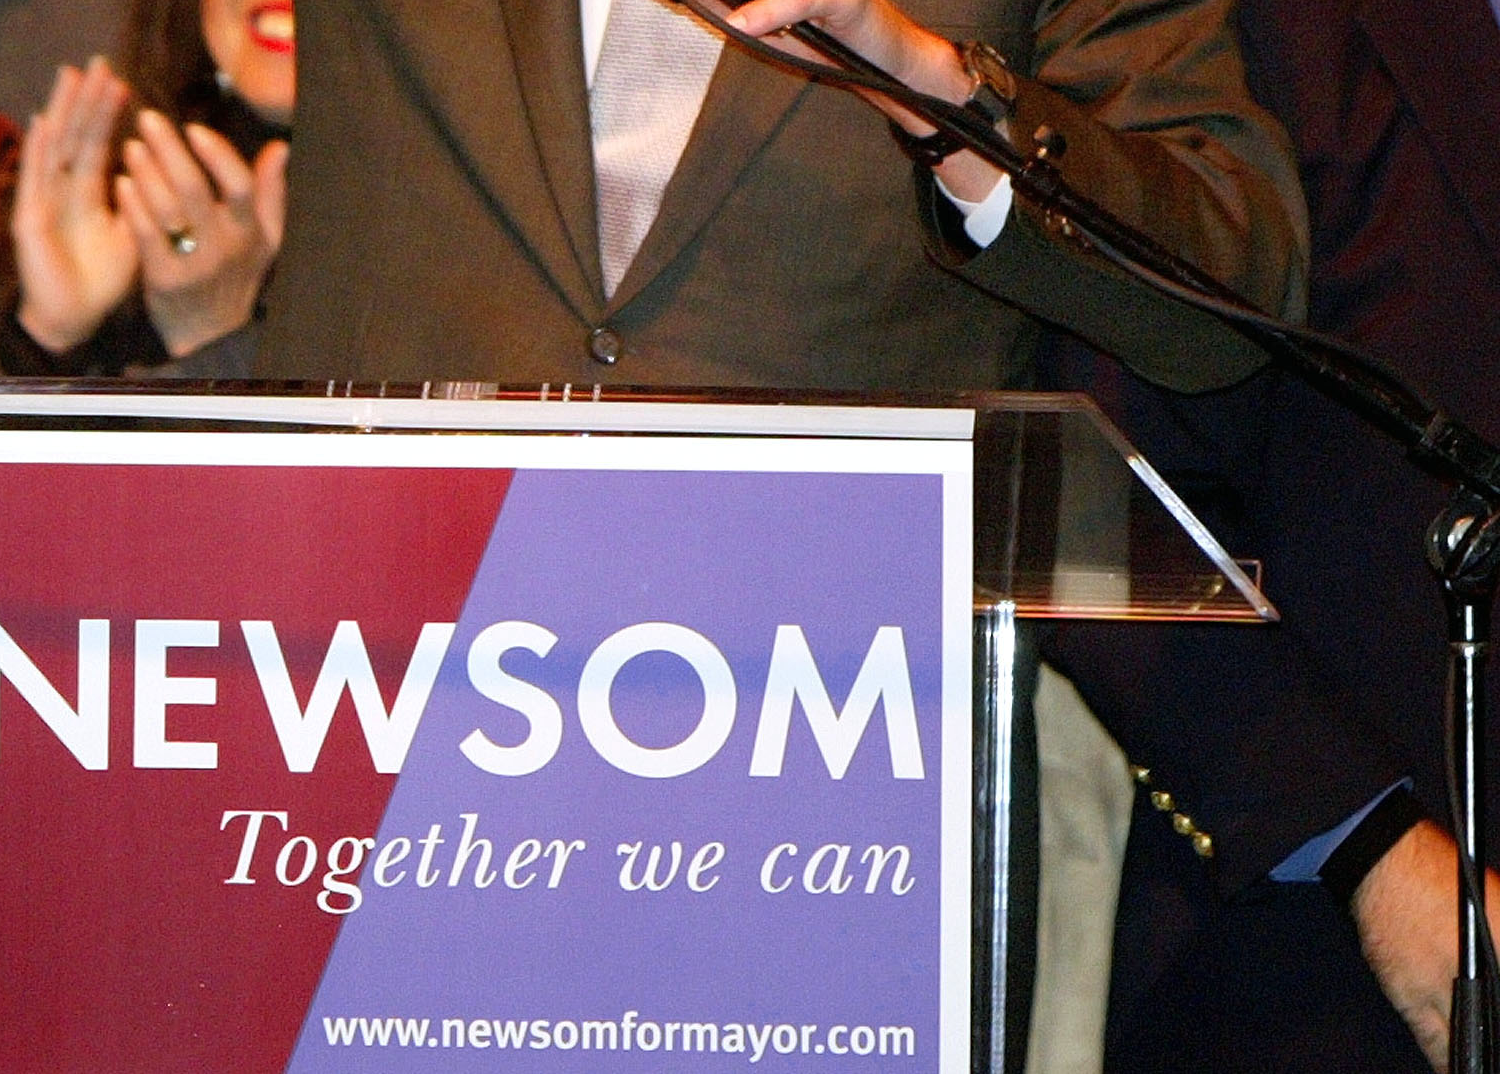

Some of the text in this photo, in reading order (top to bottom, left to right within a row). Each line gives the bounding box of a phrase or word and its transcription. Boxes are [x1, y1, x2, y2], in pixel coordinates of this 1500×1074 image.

[219, 810, 916, 914] Together we can
[322, 1010, 915, 1064] www.newsomformayor.com
